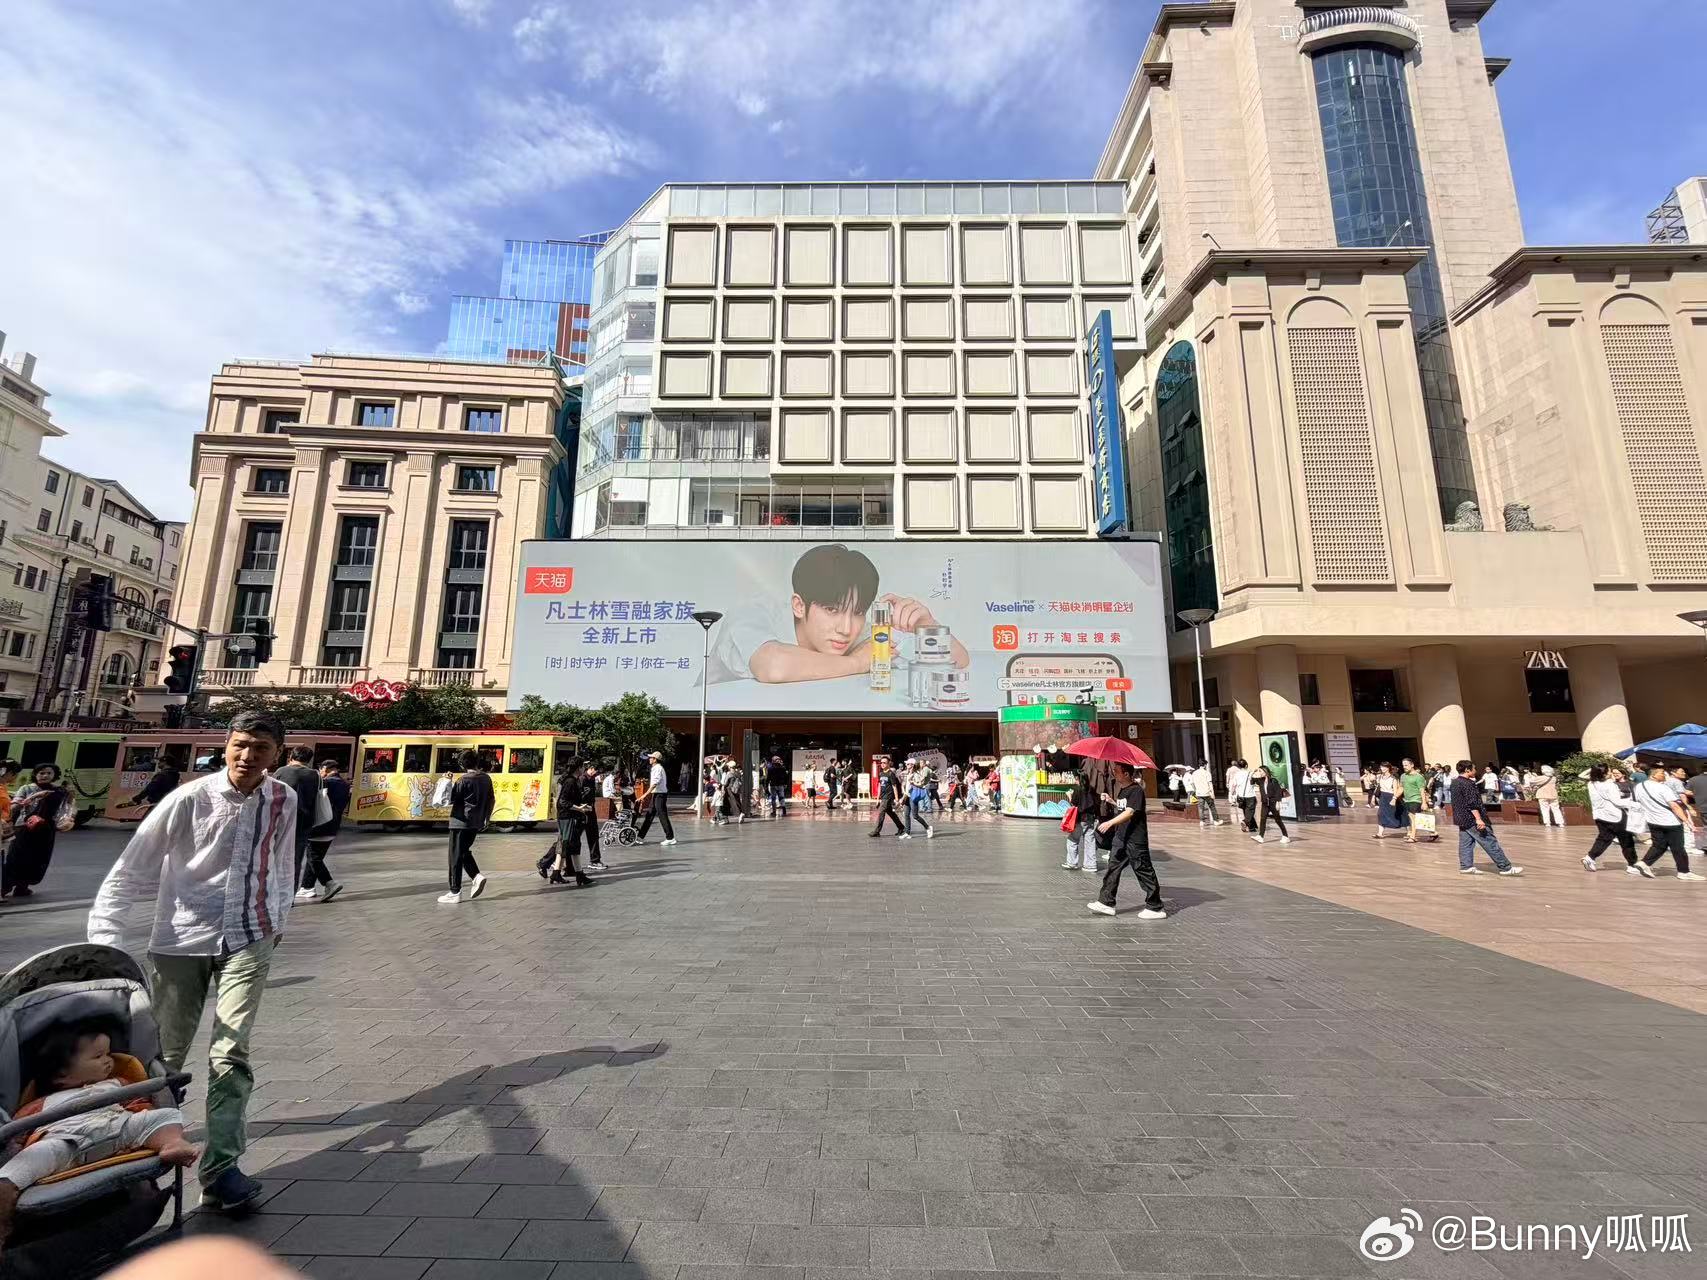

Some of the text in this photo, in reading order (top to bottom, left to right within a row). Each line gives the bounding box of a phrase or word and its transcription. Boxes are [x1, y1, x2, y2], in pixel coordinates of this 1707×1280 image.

[534, 572, 567, 588] 天猫
[985, 601, 1035, 613] Vaseline
[582, 627, 657, 645] 全新上市
[996, 629, 1016, 645] 淘
[1525, 650, 1568, 669] ZARA
